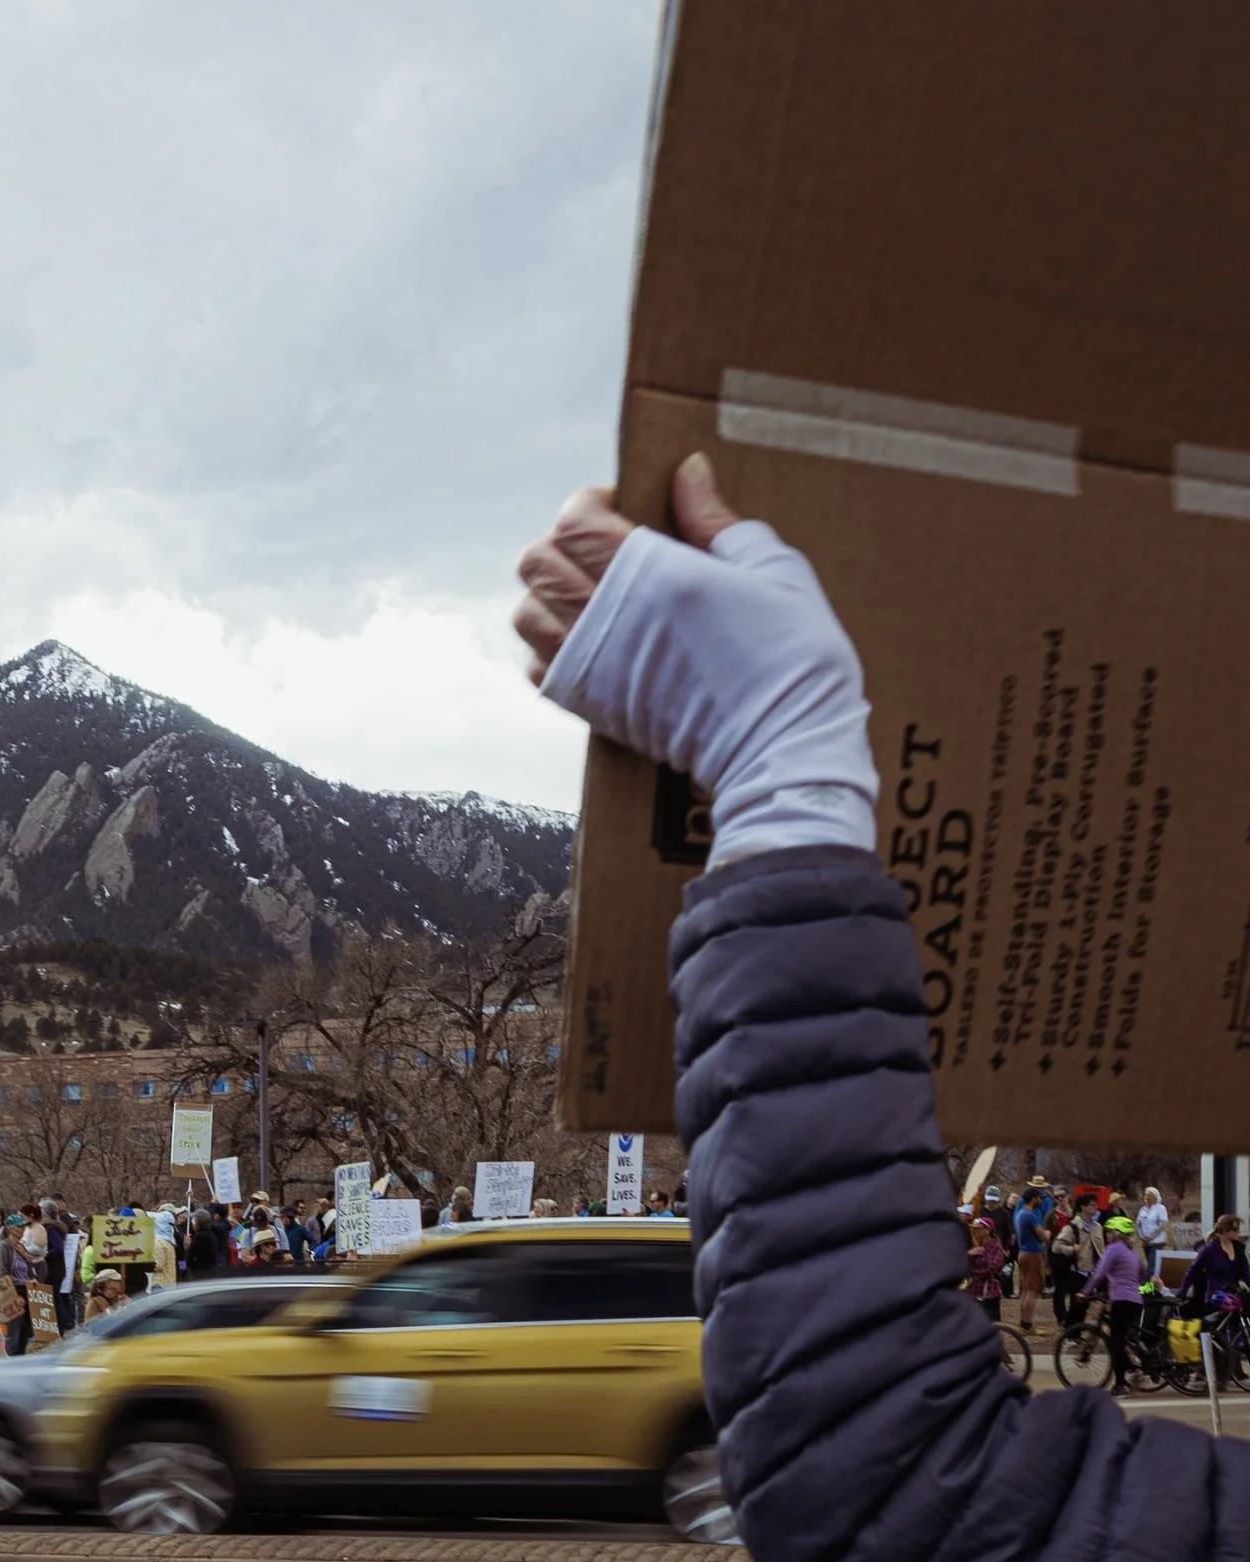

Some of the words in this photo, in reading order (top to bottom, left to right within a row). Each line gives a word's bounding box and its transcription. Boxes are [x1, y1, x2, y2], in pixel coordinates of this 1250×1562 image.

[1024, 629, 1064, 806] Pre-Scored
[889, 722, 942, 914] JECT
[1012, 922, 1048, 1046] Tri-Fold
[1031, 793, 1069, 909] Display
[1050, 686, 1080, 780] Board
[1040, 942, 1071, 1046] Sturdy
[1069, 662, 1110, 842] Corrugated
[1087, 932, 1122, 1050] Smooth
[1105, 797, 1141, 920] Interior
[1123, 666, 1159, 787] Surface
[1136, 786, 1171, 904] Storage
[1061, 844, 1107, 1049] Construction
[1113, 970, 1144, 1051] Folds
[1126, 915, 1151, 959] for
[339, 1200, 370, 1217] SCIENCE
[340, 1215, 370, 1233] SAVES
[28, 1289, 54, 1306] SCIENCE
